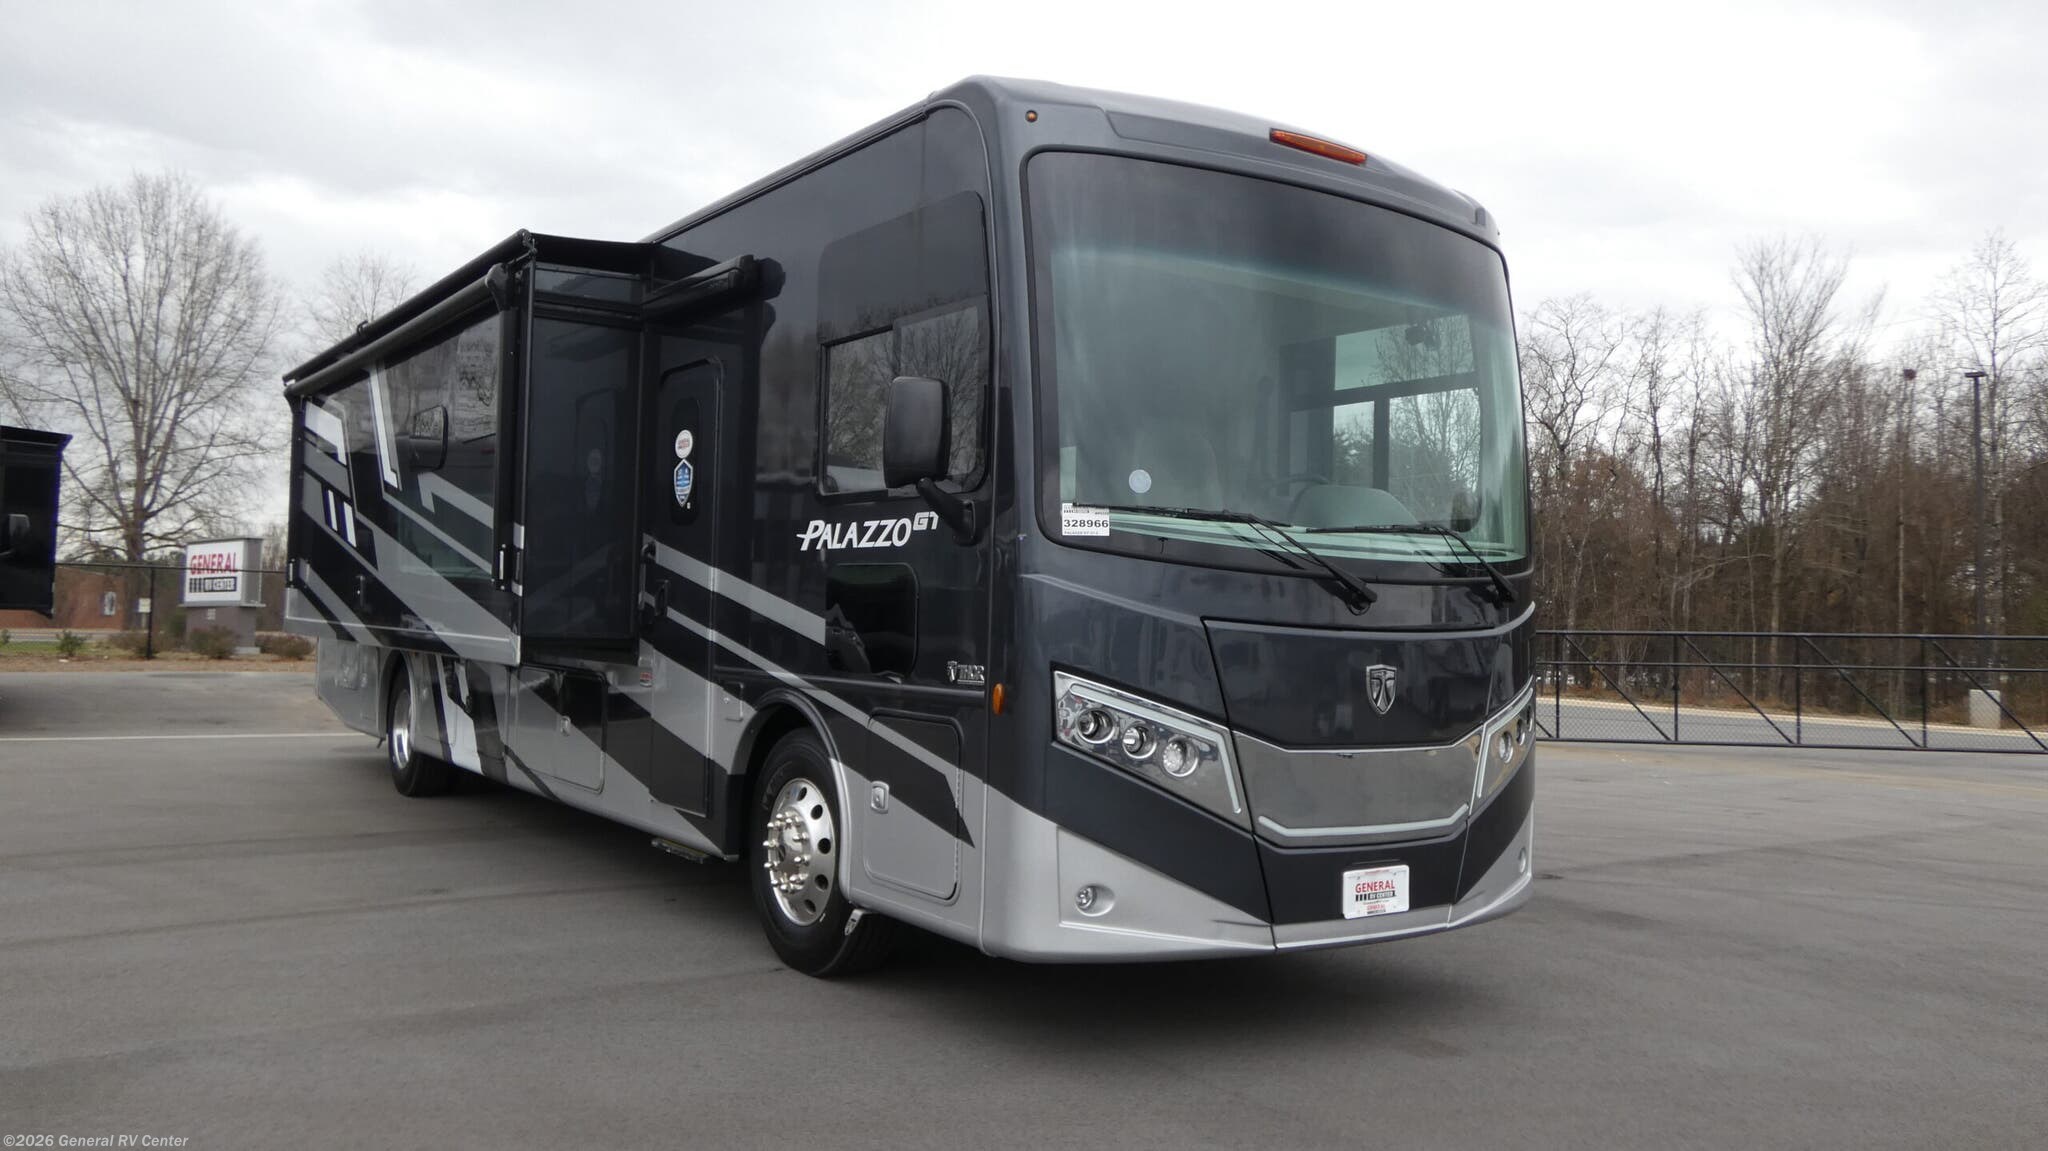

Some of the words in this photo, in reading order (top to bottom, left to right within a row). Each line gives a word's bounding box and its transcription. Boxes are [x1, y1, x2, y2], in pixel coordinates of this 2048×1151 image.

[1064, 519, 1109, 528] 328966
[796, 518, 912, 551] PALAZZO
[190, 552, 237, 575] GENERAL
[1355, 880, 1395, 893] GENERAL
